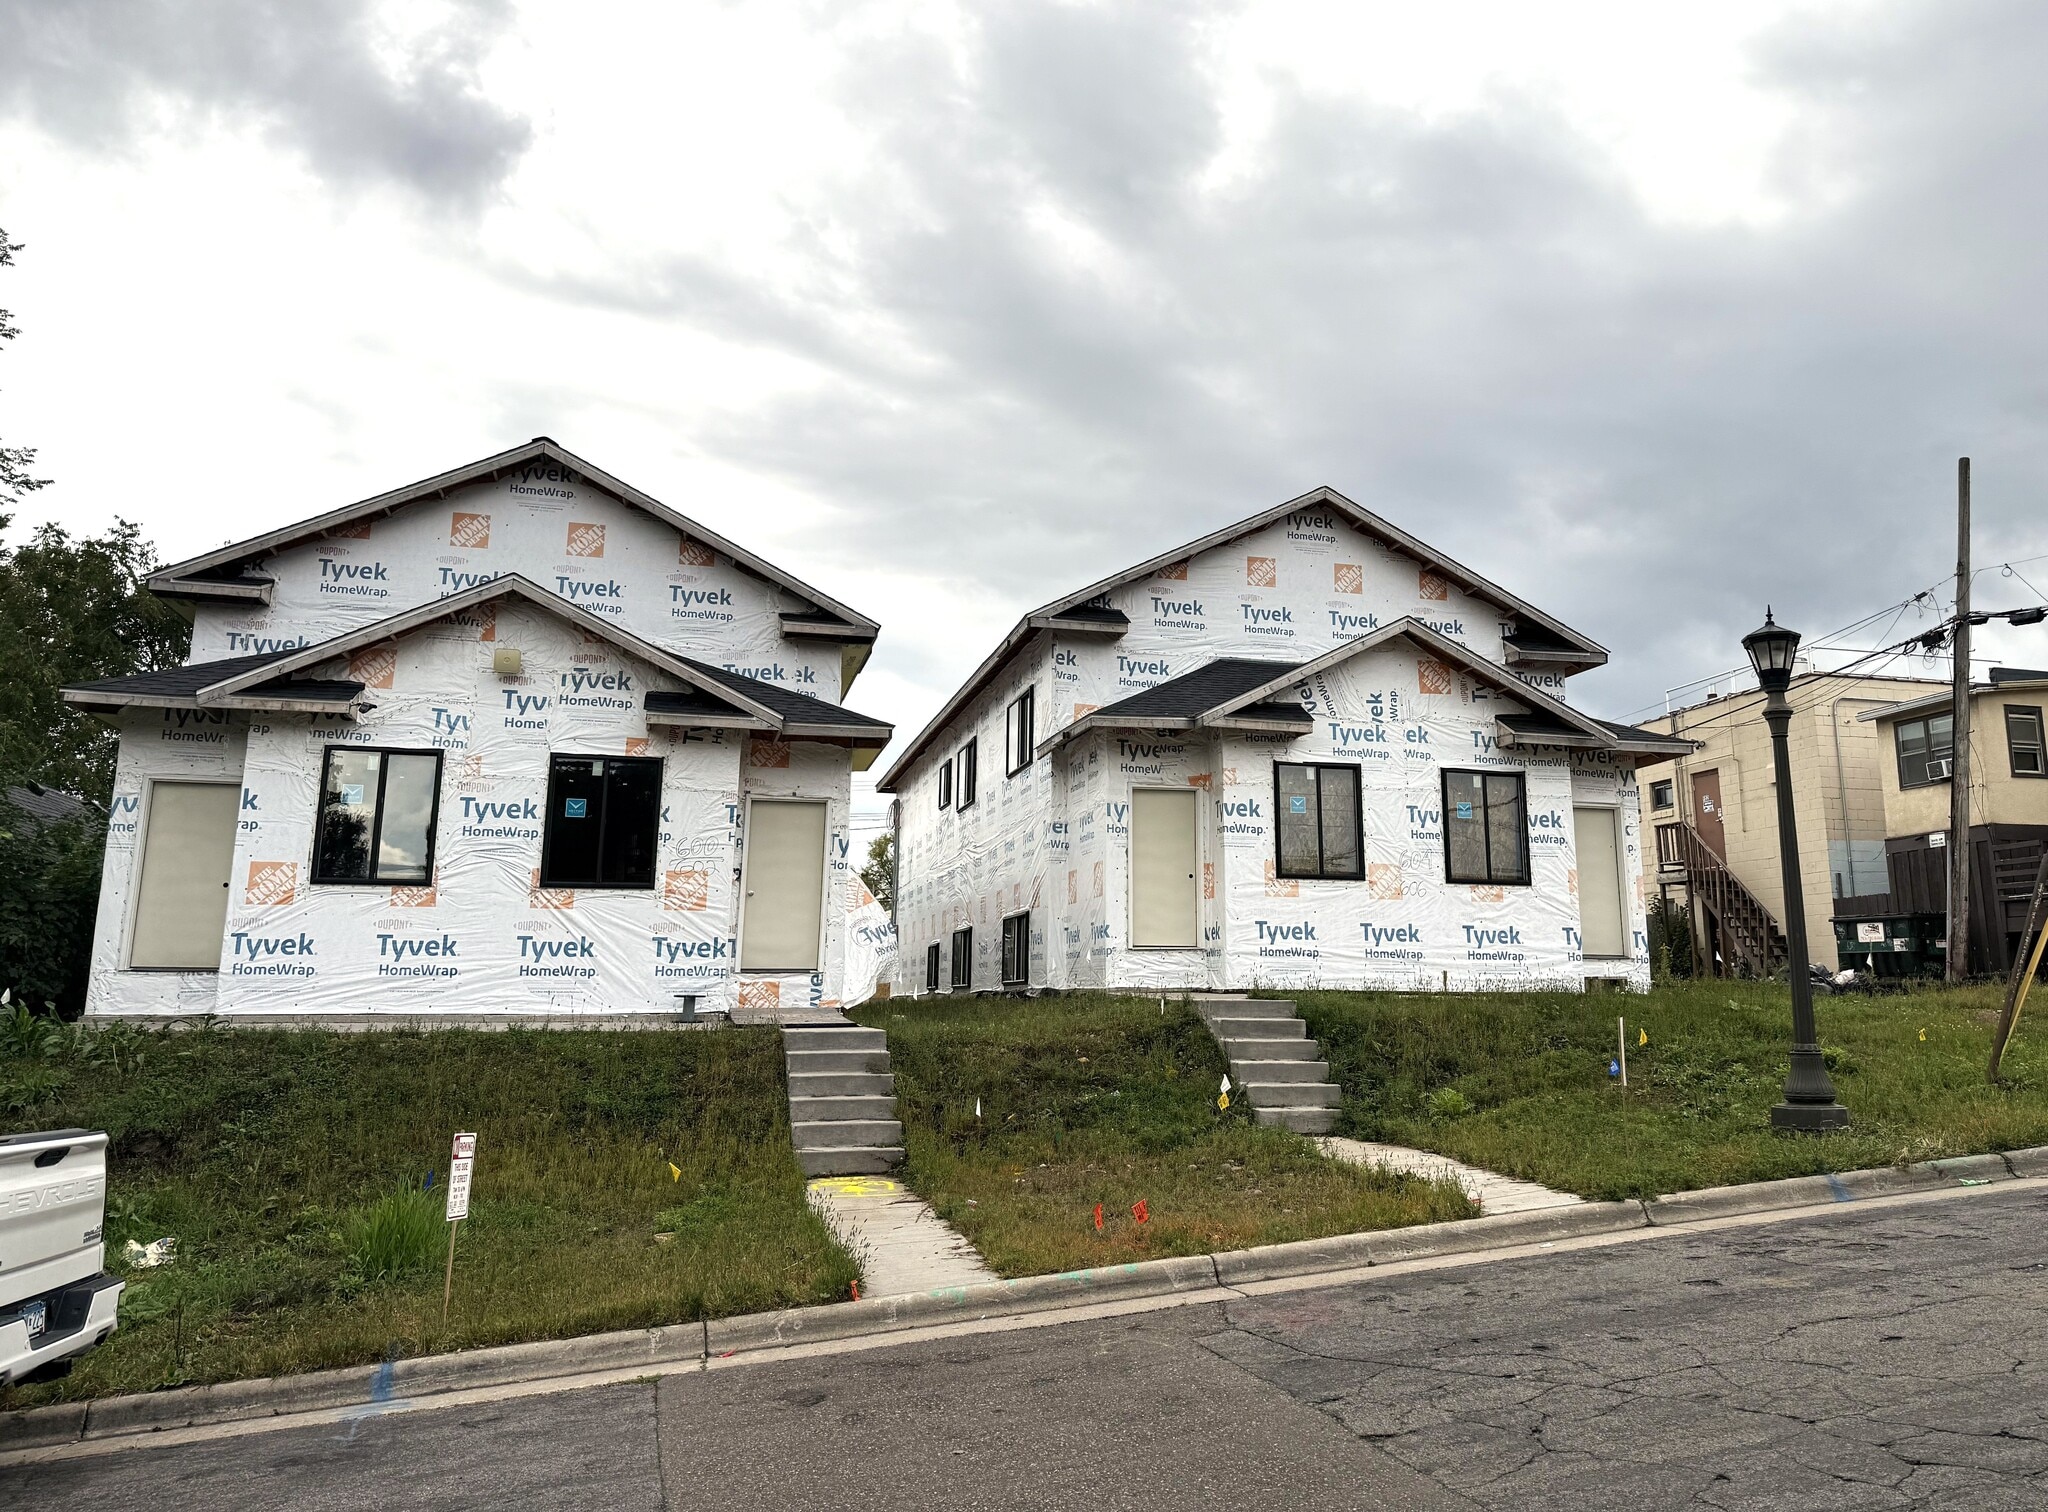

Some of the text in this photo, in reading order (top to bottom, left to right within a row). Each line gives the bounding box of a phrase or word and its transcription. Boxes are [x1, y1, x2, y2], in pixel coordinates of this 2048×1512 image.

[510, 484, 574, 499] HomeWrap
[455, 517, 471, 529] THE
[1286, 513, 1333, 530] Tyvek
[450, 515, 491, 547] HOME
[466, 528, 490, 548] DEPOT
[572, 526, 588, 539] THE
[1287, 531, 1336, 544] HomeWrap
[566, 524, 606, 556] HOME
[581, 539, 605, 557] DEPOT
[440, 556, 465, 566] DUPONT
[556, 564, 582, 574] DUPONT
[1250, 560, 1262, 571] THE
[318, 558, 387, 582] Tyvek
[1247, 558, 1276, 587] HOME
[1337, 567, 1348, 579] THE
[1259, 571, 1276, 587] DEPOT
[1334, 565, 1362, 593] HOME
[1345, 577, 1362, 594] DEPOT
[320, 583, 388, 599] HomeWrap
[556, 576, 620, 599] Tyvek
[669, 584, 731, 607] Tyvek
[575, 602, 621, 615] meWrap
[671, 608, 733, 622] HomeWrap
[1151, 597, 1203, 617] Tyvek
[1241, 604, 1292, 624] Tyvek
[1154, 618, 1205, 631] HomeWrap
[1328, 611, 1378, 630] Tyvek
[1244, 625, 1294, 637] HomeWrap
[573, 654, 603, 664] DUPONT
[1116, 656, 1170, 677] Tyvek
[503, 675, 533, 686] DUPONT
[561, 668, 631, 693] Tyvek
[1119, 677, 1162, 689] HomeWr
[502, 690, 551, 715] Tyv
[559, 695, 633, 710] HomeWrap
[1293, 678, 1317, 713] vek
[1315, 673, 1337, 717] omeWra
[504, 717, 549, 729] Home
[161, 730, 224, 743] HomeWr
[311, 728, 372, 744] meWrap
[1328, 723, 1386, 745] Tyvek
[1117, 739, 1160, 762] Tyve
[1333, 747, 1390, 760] HomeWrap
[1405, 749, 1432, 760] Wrap
[1121, 763, 1162, 775] HomeW
[1571, 768, 1614, 780] HomeWra
[460, 797, 538, 824] Tyvek
[1406, 805, 1440, 828] Tyv
[1528, 811, 1562, 828] vek
[462, 826, 539, 841] HomeWrap
[676, 836, 719, 858] 600
[254, 866, 273, 883] THE
[247, 862, 298, 905] HOME
[378, 919, 409, 930] DUPONT
[517, 921, 548, 931] DUPONT
[859, 922, 898, 944] Tyve
[1255, 921, 1316, 945] Tyvek
[1360, 923, 1420, 946] Tyvek
[1462, 925, 1521, 949] Tyvek
[231, 933, 314, 961] Tyvek
[376, 934, 457, 962] Tyvek
[517, 936, 594, 963] Tyvek
[652, 937, 726, 964] Tyvek
[1259, 946, 1319, 960] HomeWrap
[1365, 948, 1423, 961] HomeWrap
[1468, 951, 1525, 963] HomeWrap
[232, 962, 315, 978] HomeWrap
[379, 964, 458, 978] HomeWrap
[519, 965, 596, 979] HomeWrap
[655, 966, 727, 979] HomeWrap
